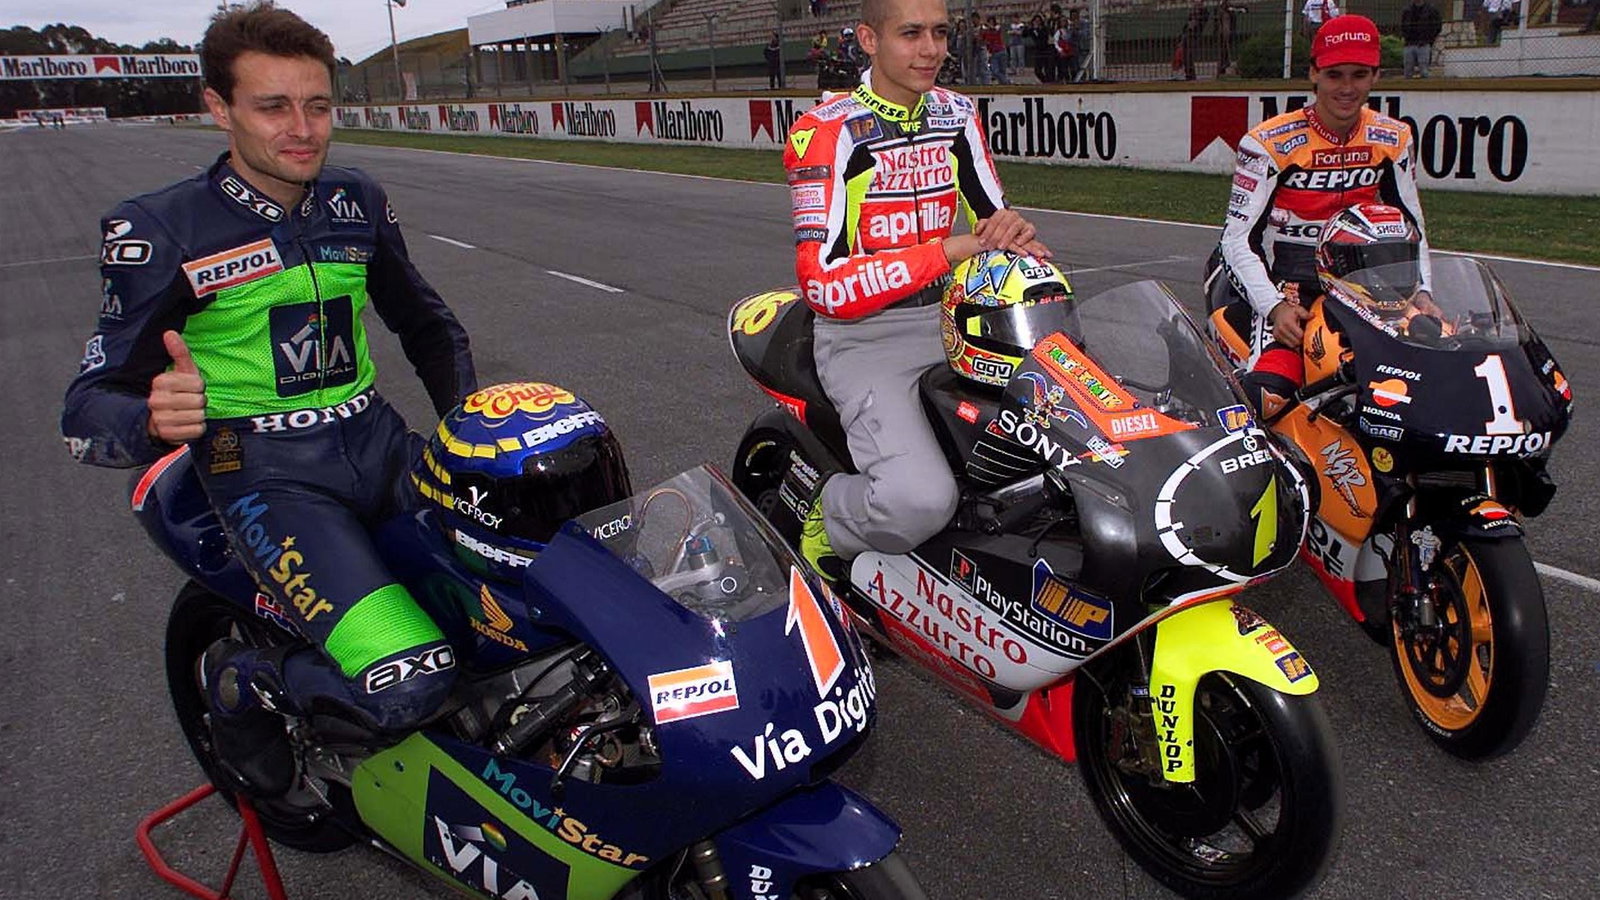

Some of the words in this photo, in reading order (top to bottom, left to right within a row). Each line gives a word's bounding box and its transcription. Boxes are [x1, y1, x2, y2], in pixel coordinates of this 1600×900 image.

[1324, 31, 1371, 47] Fortuna
[3, 57, 86, 76] Marlboro
[122, 56, 198, 75] Marlboro
[501, 104, 538, 134] Marlboro
[565, 102, 616, 137] Marlboro
[655, 101, 724, 142] Marlboro
[931, 119, 966, 127] DUNLO
[869, 165, 953, 191] Azzurro
[878, 145, 947, 174] Nastro
[870, 200, 951, 244] aprilia
[198, 251, 276, 285] REPSOL
[807, 259, 912, 313] aprilia
[280, 335, 351, 373] VIA
[976, 361, 1009, 378] agv
[1376, 365, 1422, 381] REPSOL
[251, 390, 375, 433] HOND
[1362, 405, 1402, 421] HONDA
[1474, 354, 1525, 434] 1
[998, 409, 1082, 472] SONY
[1112, 413, 1160, 434] DIESEL
[1250, 473, 1278, 568] 1
[227, 492, 335, 622] MoviStar
[785, 565, 846, 700] 1
[867, 569, 996, 679] Azzurro
[916, 567, 1028, 664] Nastro
[975, 576, 1087, 652] PlayStation
[470, 616, 529, 653] HONDA
[657, 679, 732, 704] REPSOL
[730, 722, 812, 780] Vía
[814, 665, 876, 745] Digit
[1160, 685, 1183, 773] DUNLOP
[482, 758, 649, 866] MoviStar
